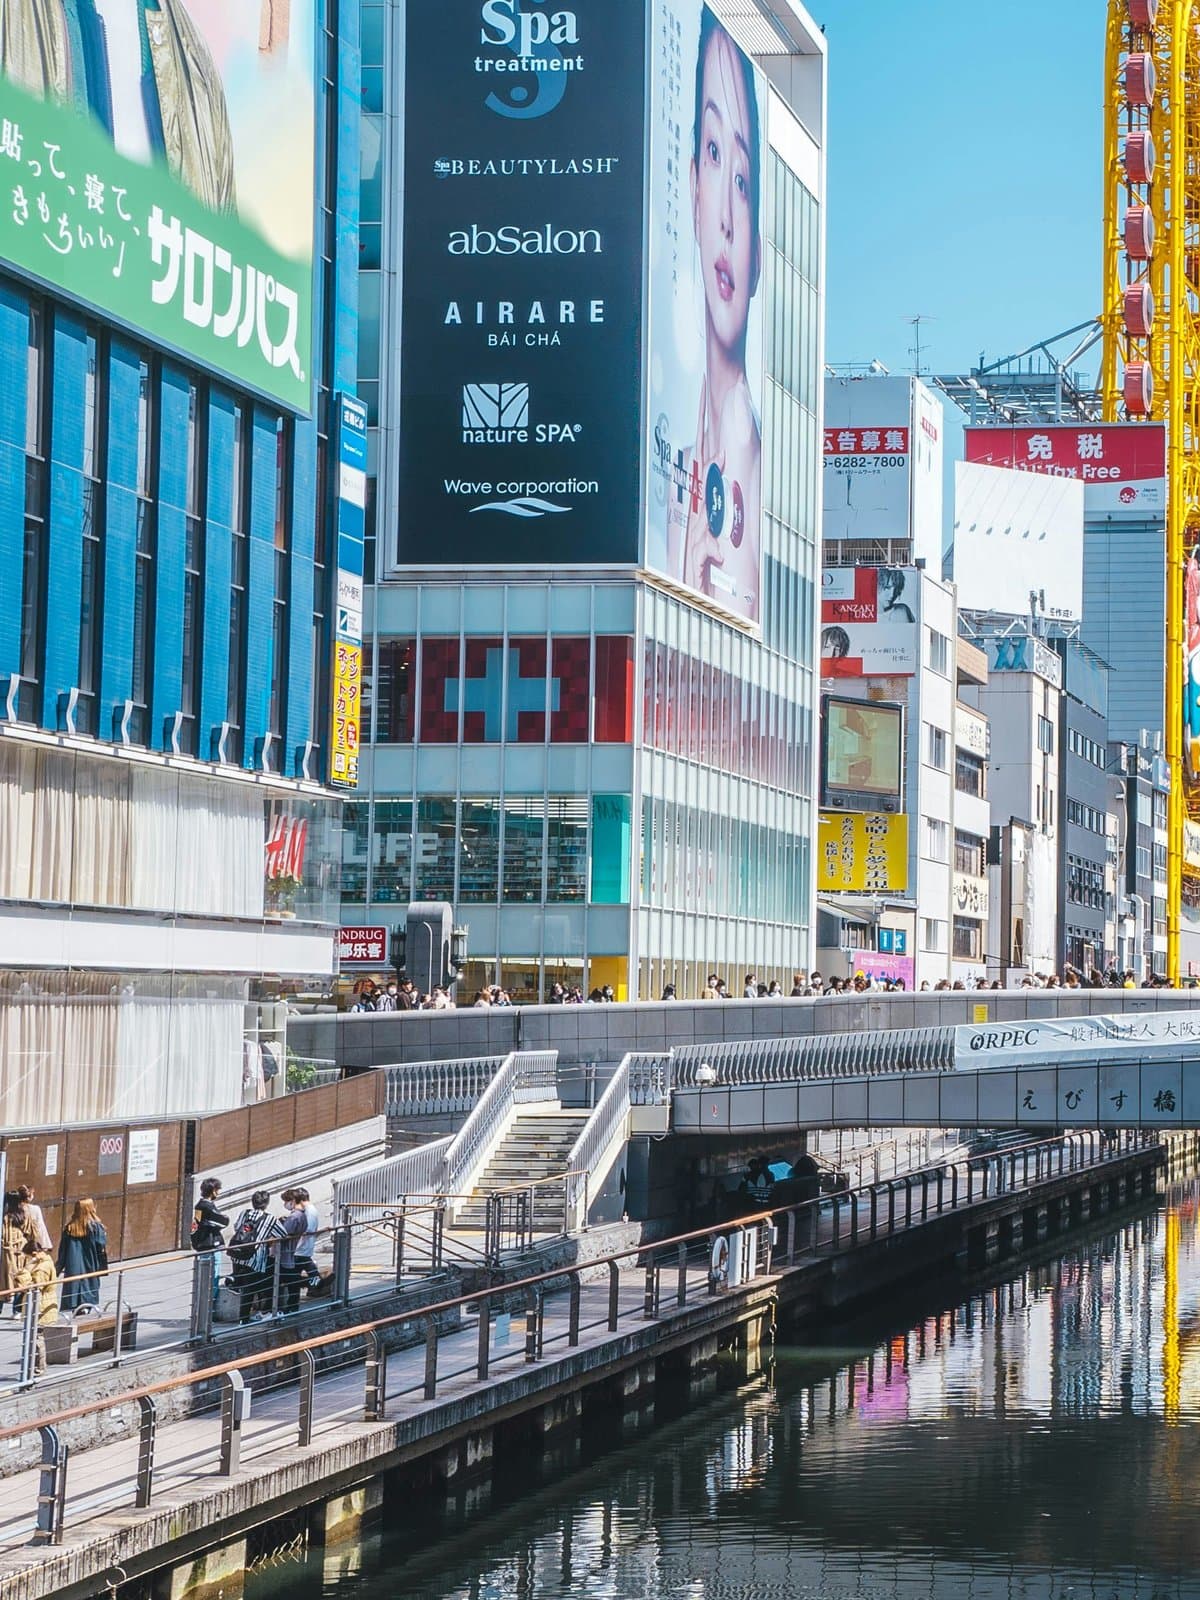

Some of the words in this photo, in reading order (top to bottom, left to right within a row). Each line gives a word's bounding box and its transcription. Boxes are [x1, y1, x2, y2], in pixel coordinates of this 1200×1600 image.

[481, 0, 580, 57] Spa
[474, 55, 585, 72] treatment
[447, 223, 602, 255] abSalon
[444, 300, 605, 324] AIRARE
[463, 427, 529, 444] nature
[1027, 434, 1104, 460] 免税
[1082, 464, 1121, 479] Free
[444, 480, 492, 494] Wave
[497, 478, 599, 497] corporation
[1022, 1089, 1176, 1113] えびす橋
